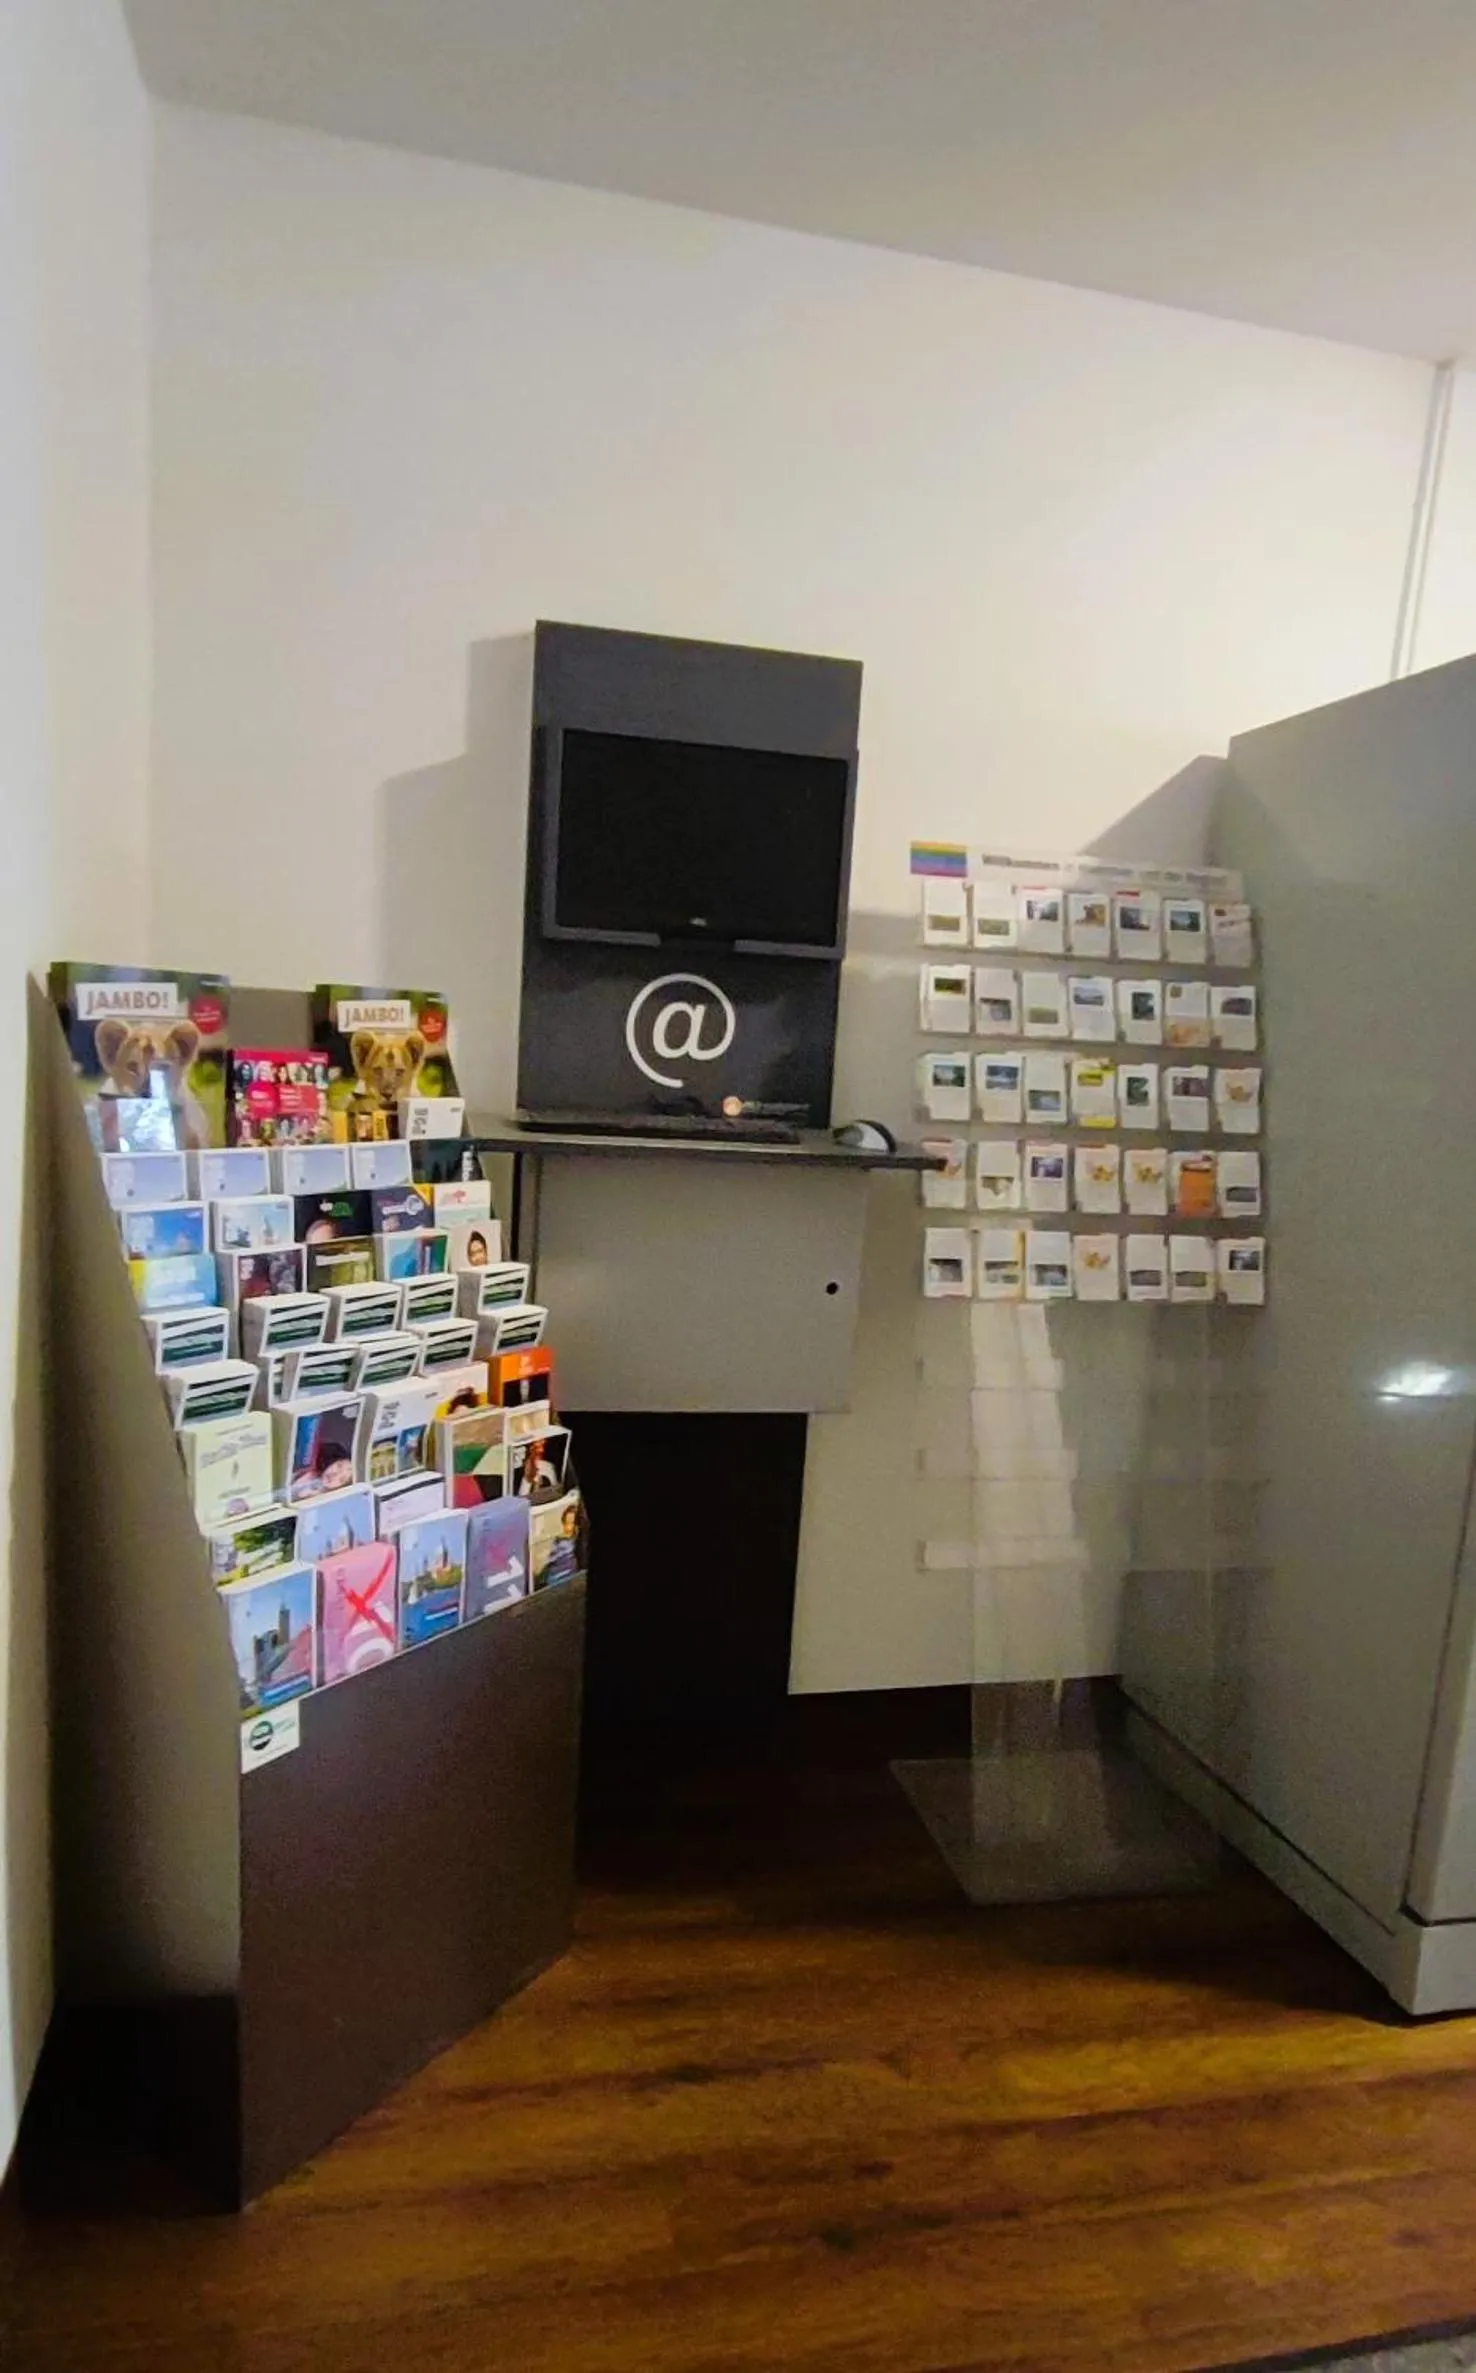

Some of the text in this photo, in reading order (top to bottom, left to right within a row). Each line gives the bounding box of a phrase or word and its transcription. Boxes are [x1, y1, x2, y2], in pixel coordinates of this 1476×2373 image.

[86, 991, 169, 1014] JAMBO!
[344, 1006, 405, 1028] JAMBO!
[626, 972, 736, 1088] @
